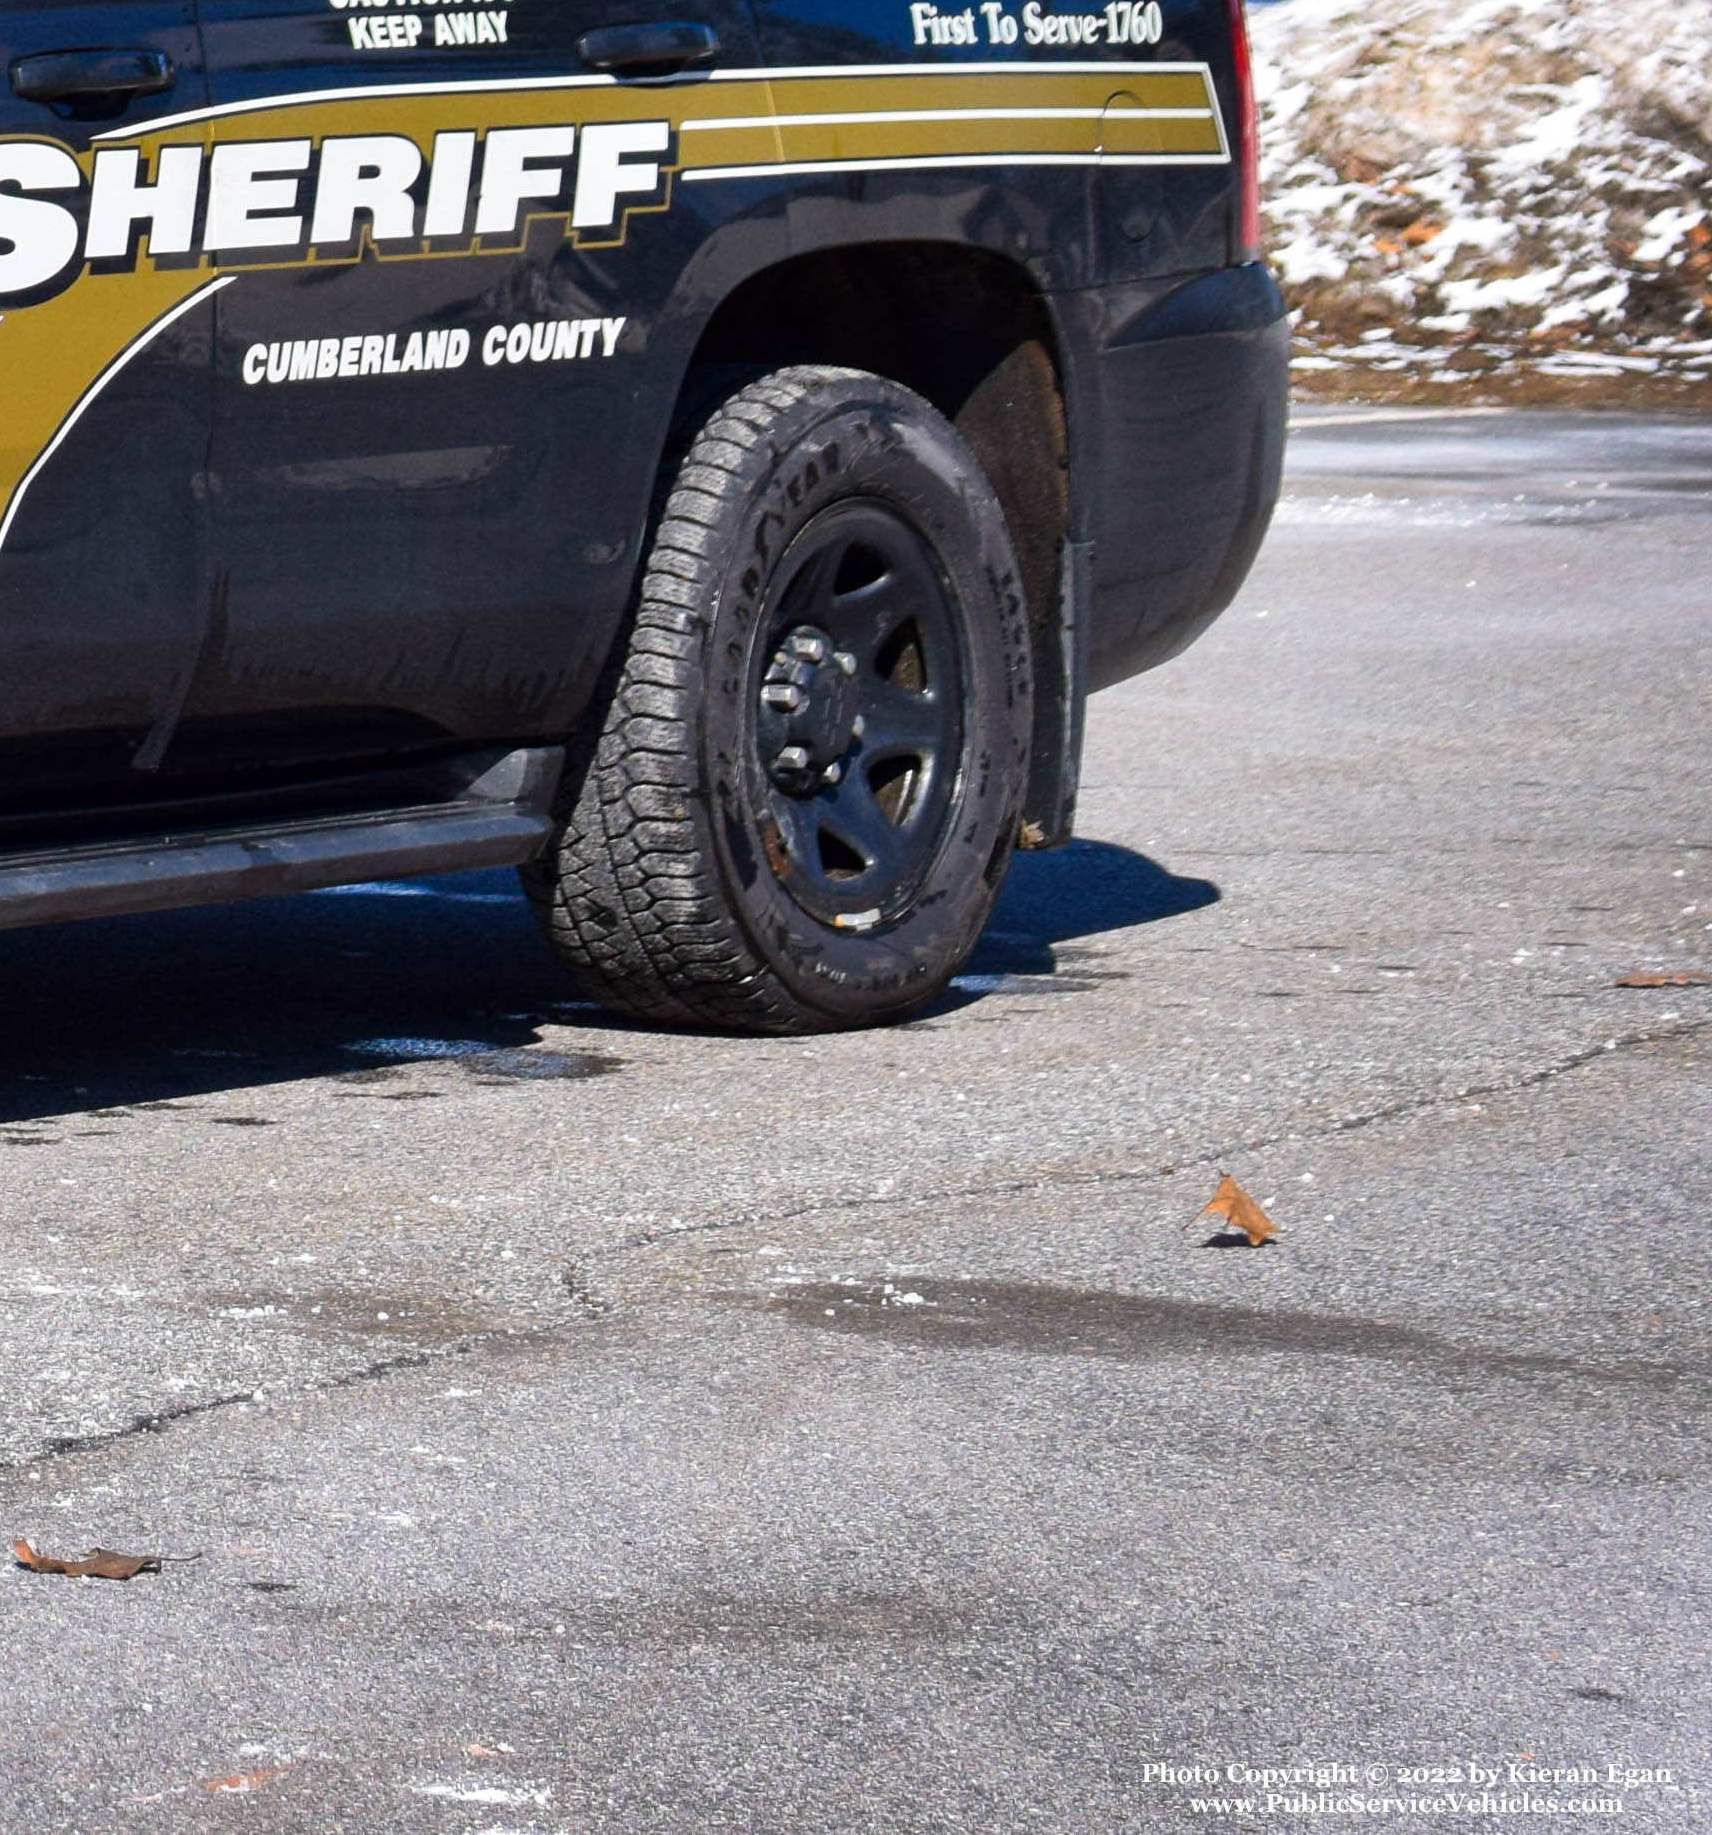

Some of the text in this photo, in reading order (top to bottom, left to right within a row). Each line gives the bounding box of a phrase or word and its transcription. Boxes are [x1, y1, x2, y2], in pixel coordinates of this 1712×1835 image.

[347, 10, 509, 51] KEEP AWAY
[909, 1, 1163, 46] First To Serve-1760
[242, 316, 627, 386] CUMBERLAND COUNTY
